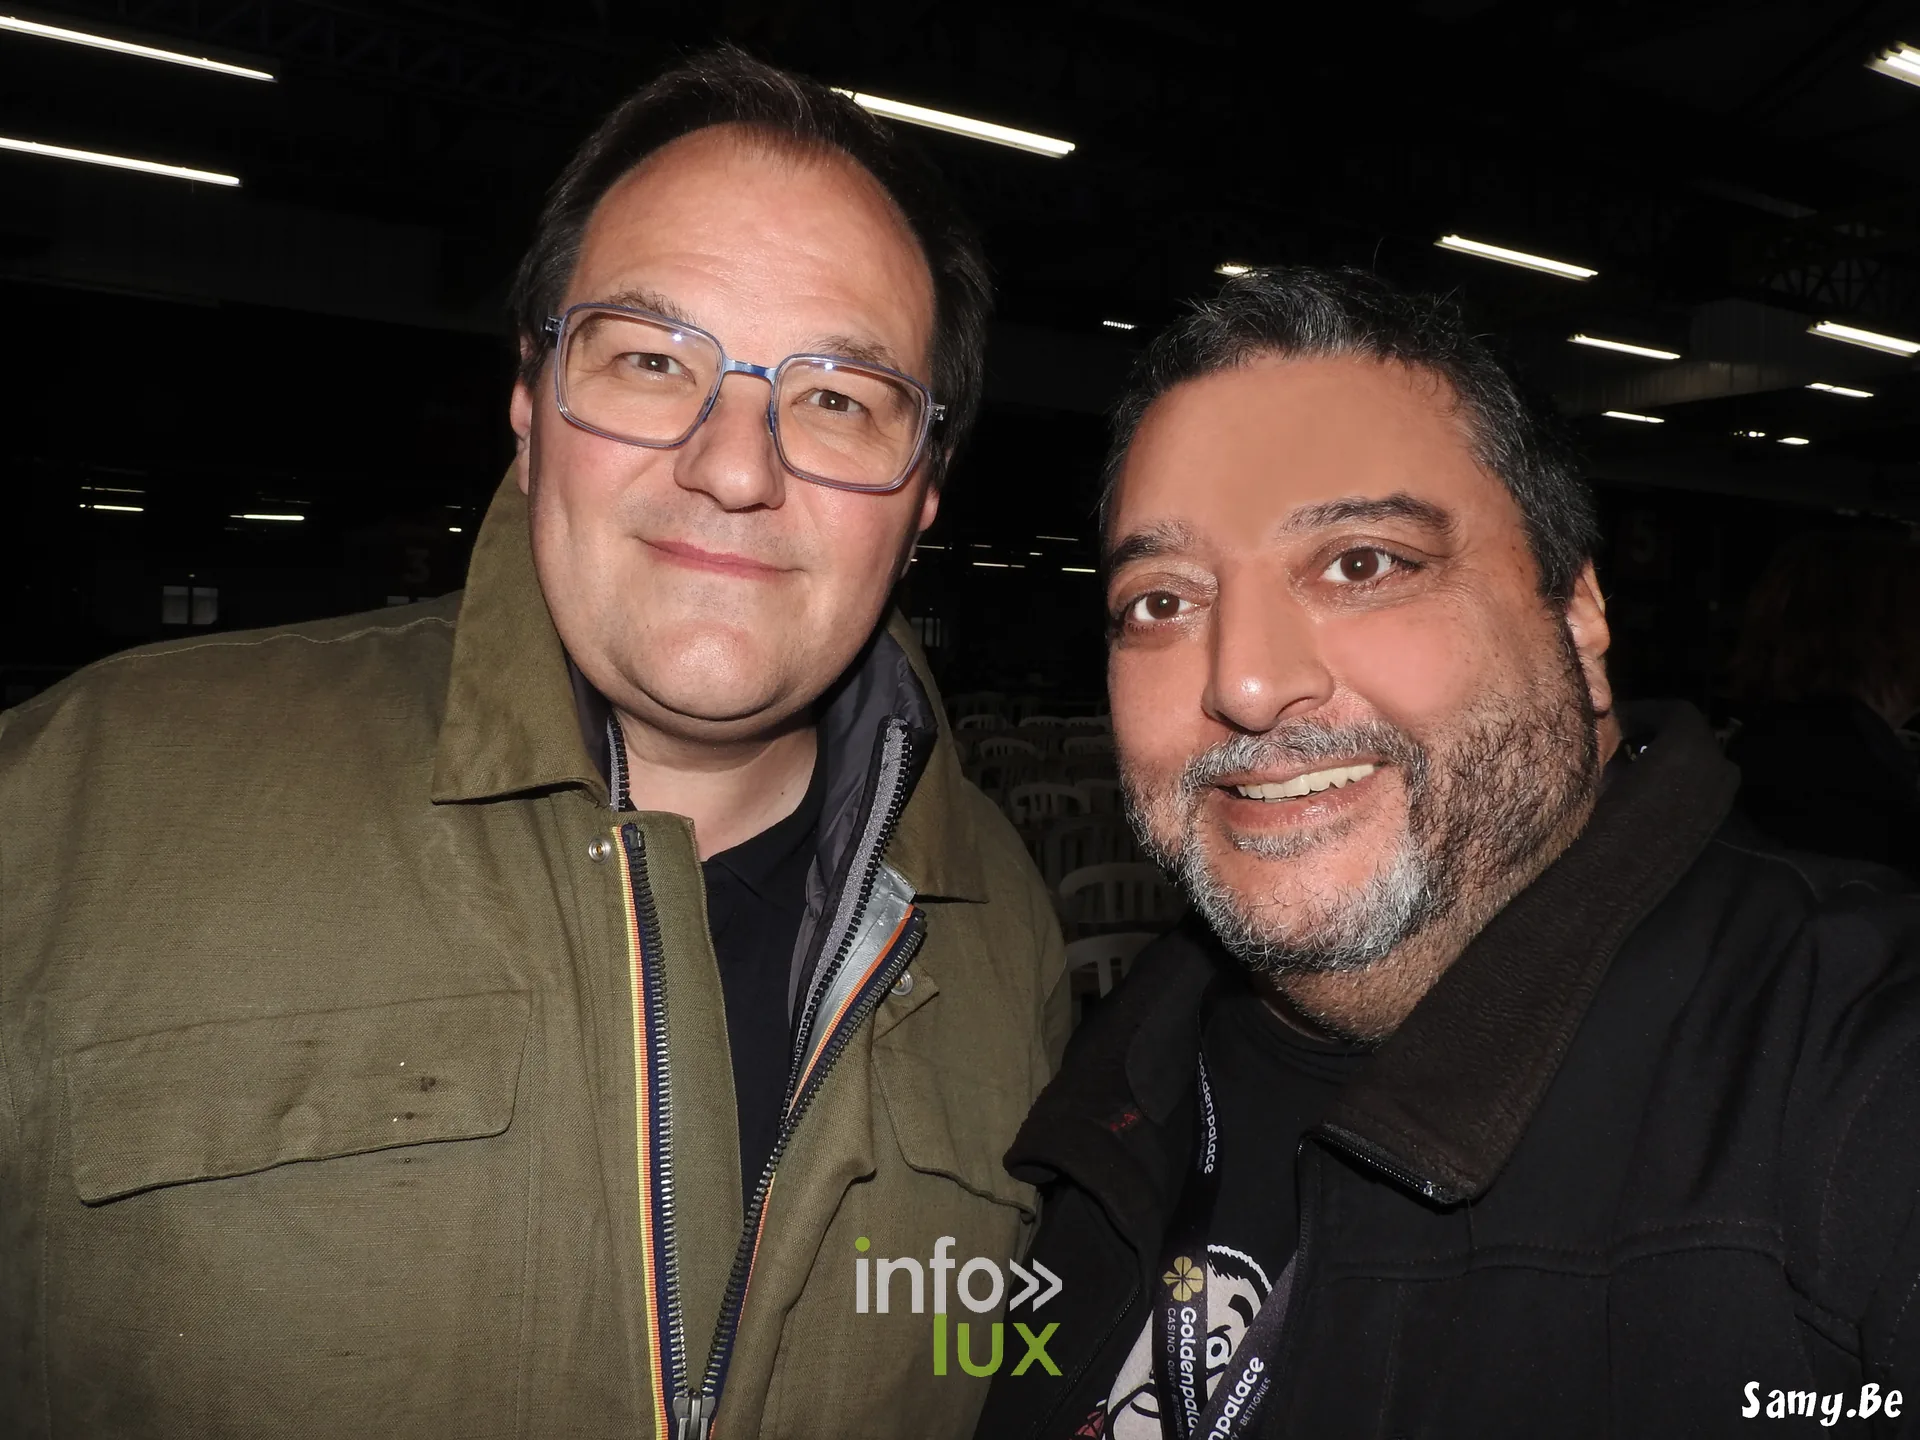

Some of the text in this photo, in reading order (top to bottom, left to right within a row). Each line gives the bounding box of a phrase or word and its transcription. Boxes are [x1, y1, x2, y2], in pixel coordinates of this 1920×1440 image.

[403, 546, 430, 583] 3
[1166, 1307, 1177, 1354] CASINO
[1179, 1306, 1201, 1437] Goldenpala
[1239, 1377, 1272, 1427] BETTIGNIES
